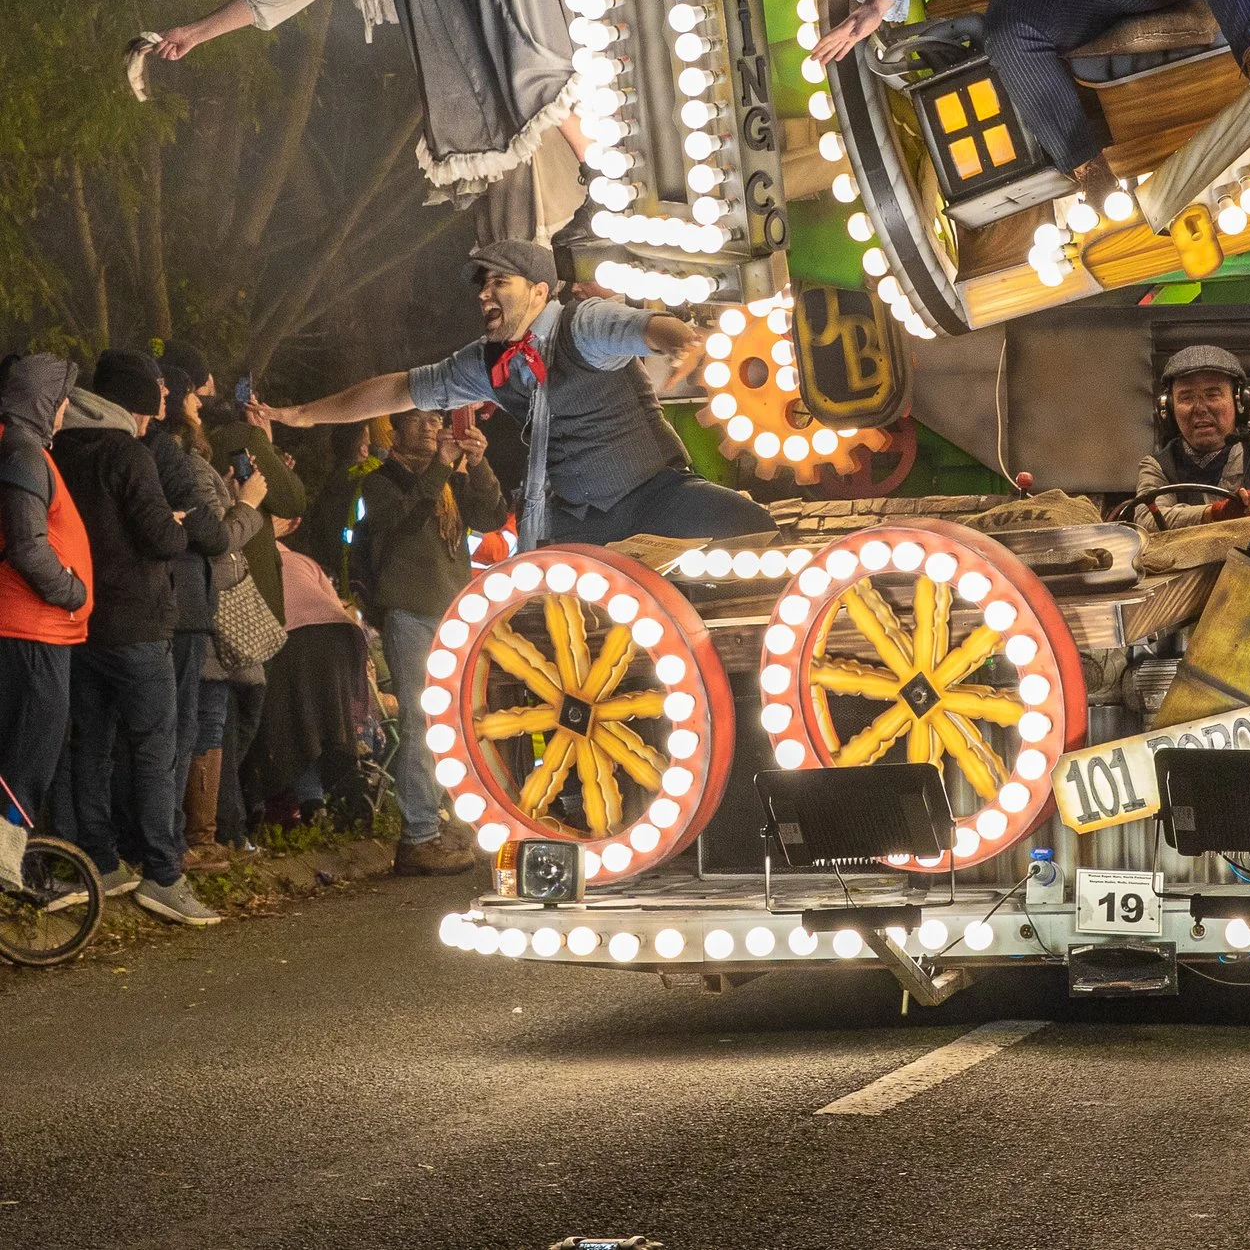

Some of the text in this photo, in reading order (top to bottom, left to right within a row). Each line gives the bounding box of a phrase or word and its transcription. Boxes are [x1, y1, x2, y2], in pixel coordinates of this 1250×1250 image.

[745, 169, 788, 250] CO
[1066, 747, 1147, 825] 101
[1098, 892, 1144, 923] 19
